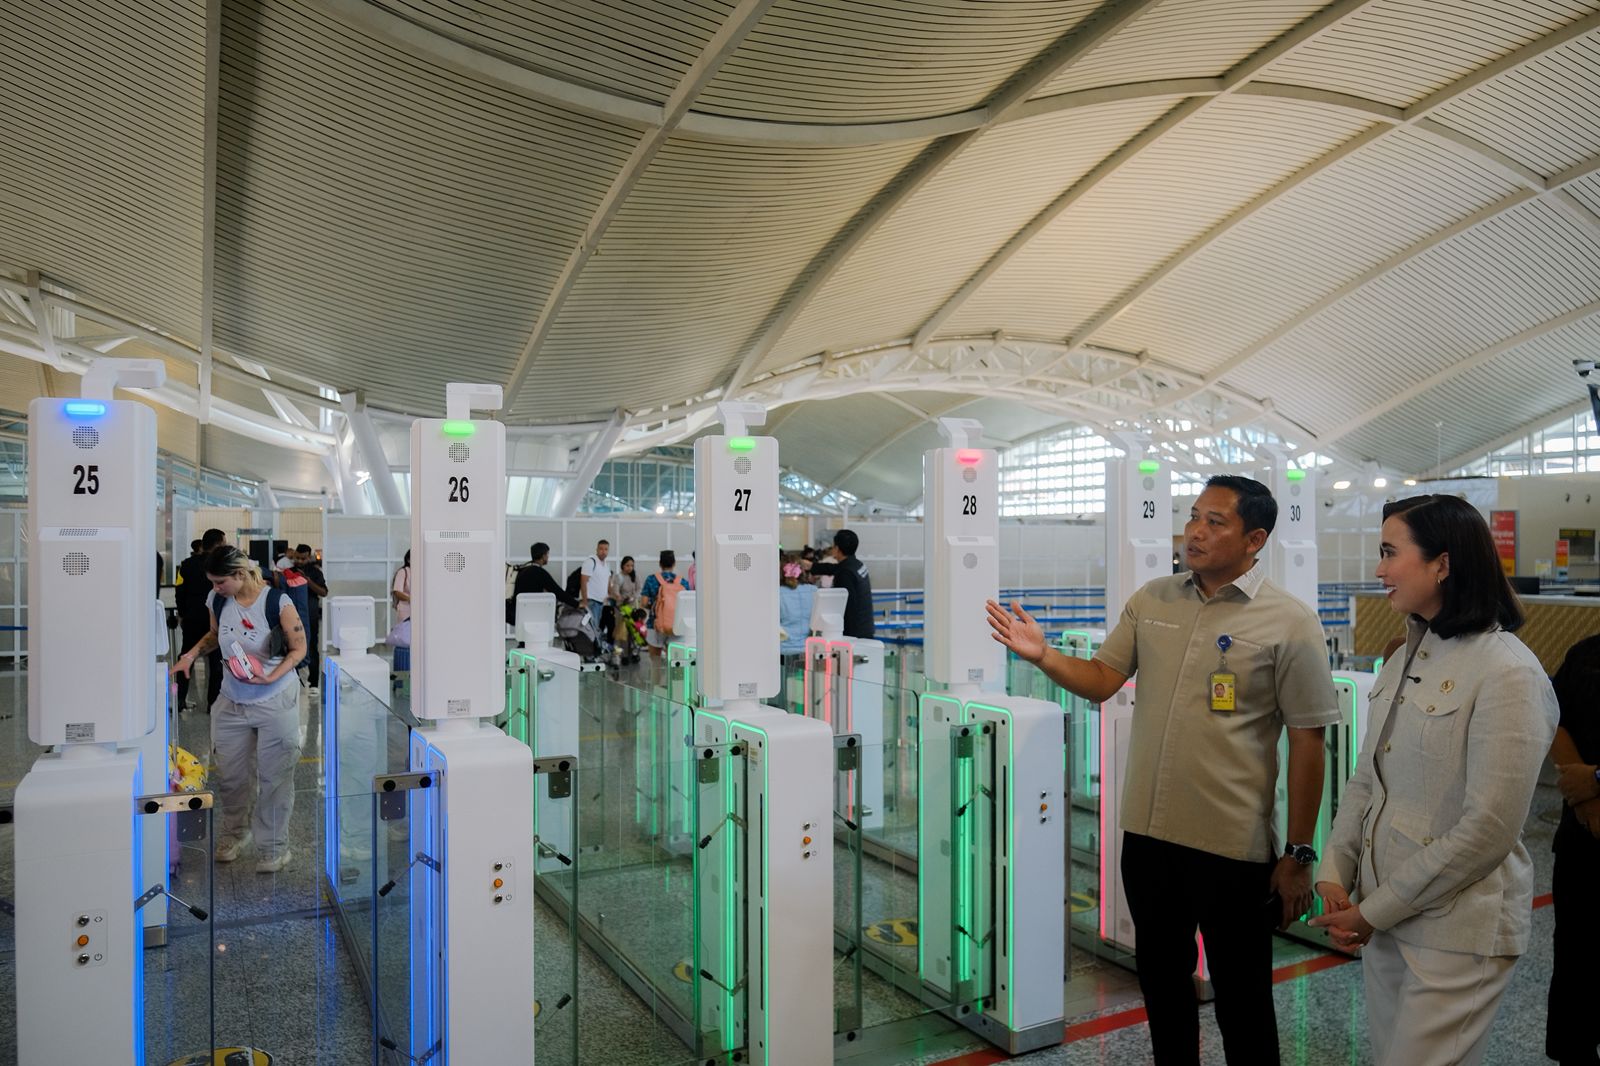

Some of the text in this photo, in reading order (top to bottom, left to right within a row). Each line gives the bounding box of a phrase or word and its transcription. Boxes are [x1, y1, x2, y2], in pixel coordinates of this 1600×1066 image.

[73, 465, 100, 495] 25
[448, 477, 470, 503] 26
[734, 489, 752, 512] 27
[962, 495, 977, 516] 28
[1143, 500, 1155, 519] 29
[1290, 504, 1301, 522] 30
